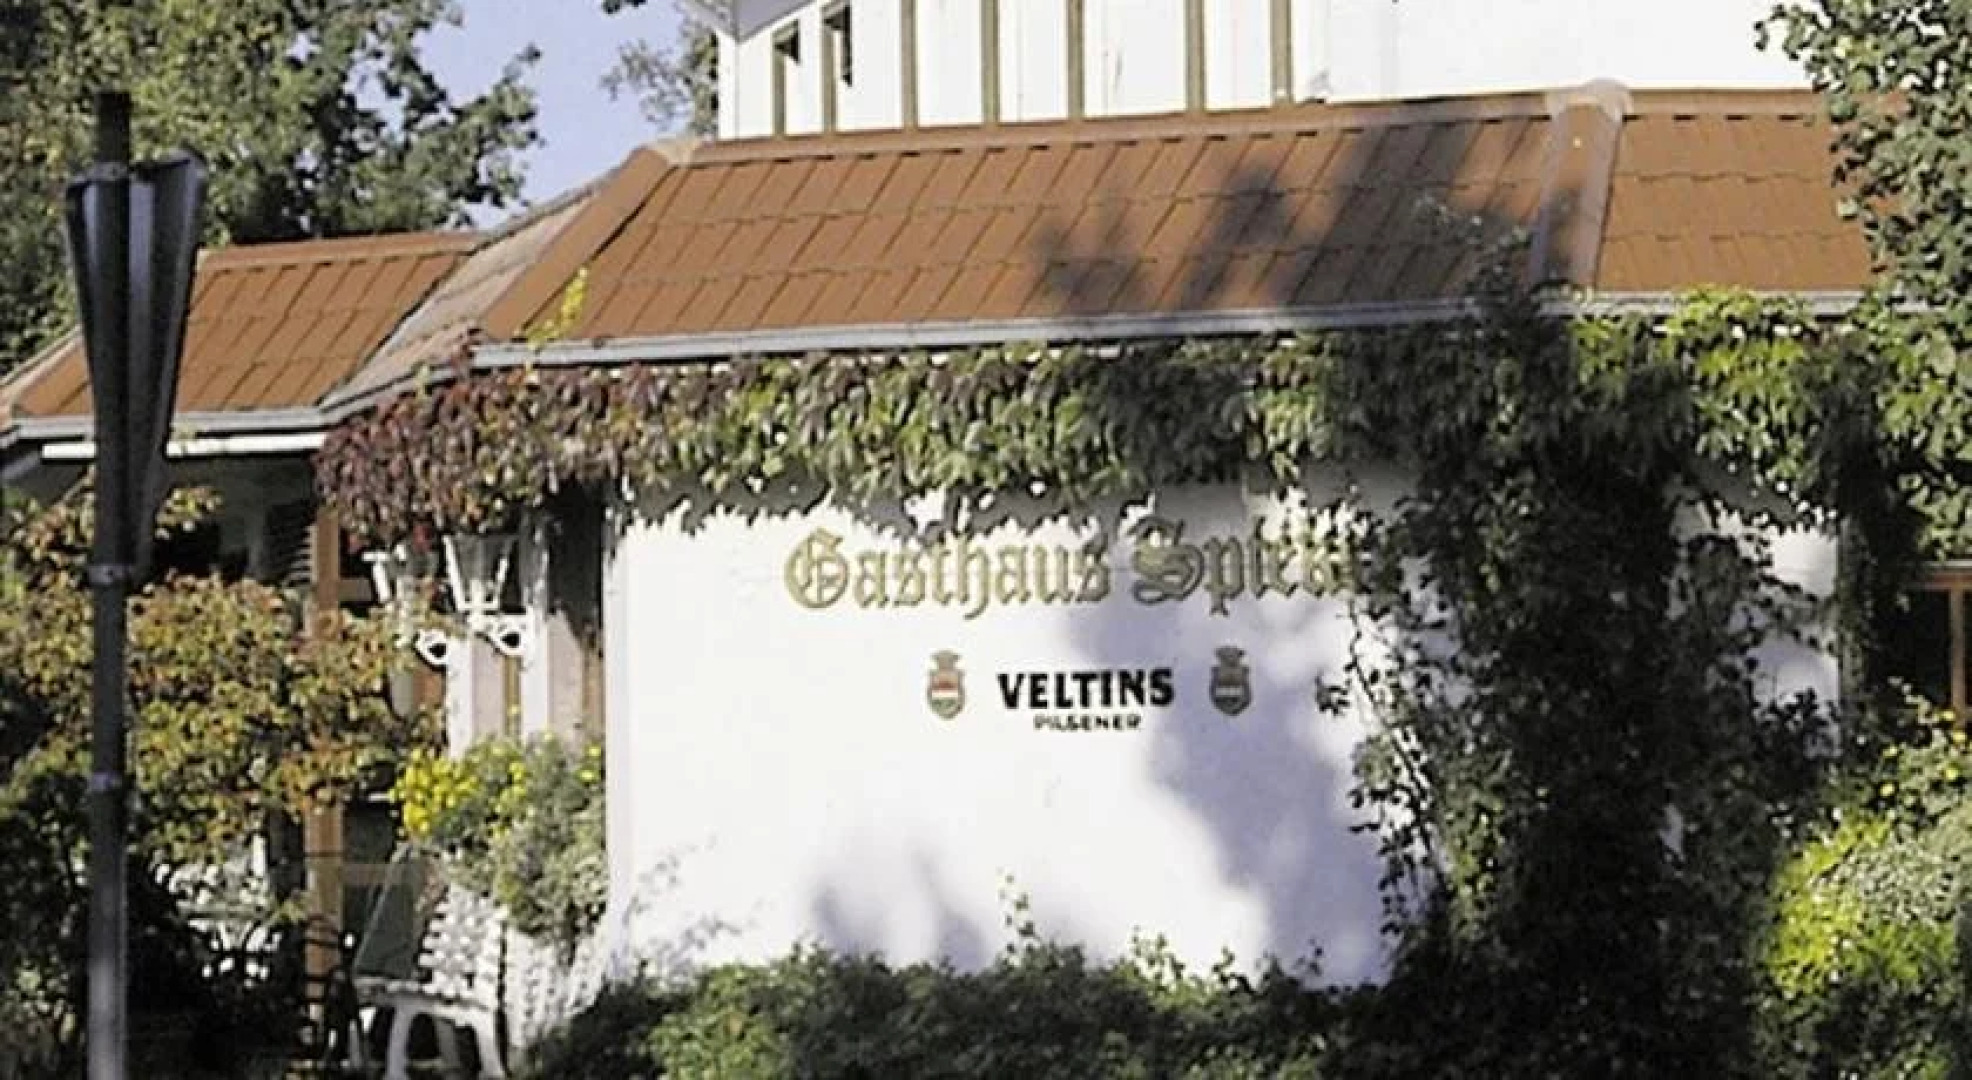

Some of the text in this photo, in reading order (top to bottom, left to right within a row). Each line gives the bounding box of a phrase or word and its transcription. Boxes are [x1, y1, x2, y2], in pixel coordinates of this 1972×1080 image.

[785, 527, 1112, 620] Gasthaus
[997, 667, 1175, 709] VELTINS
[1033, 714, 1142, 732] PILSENER
